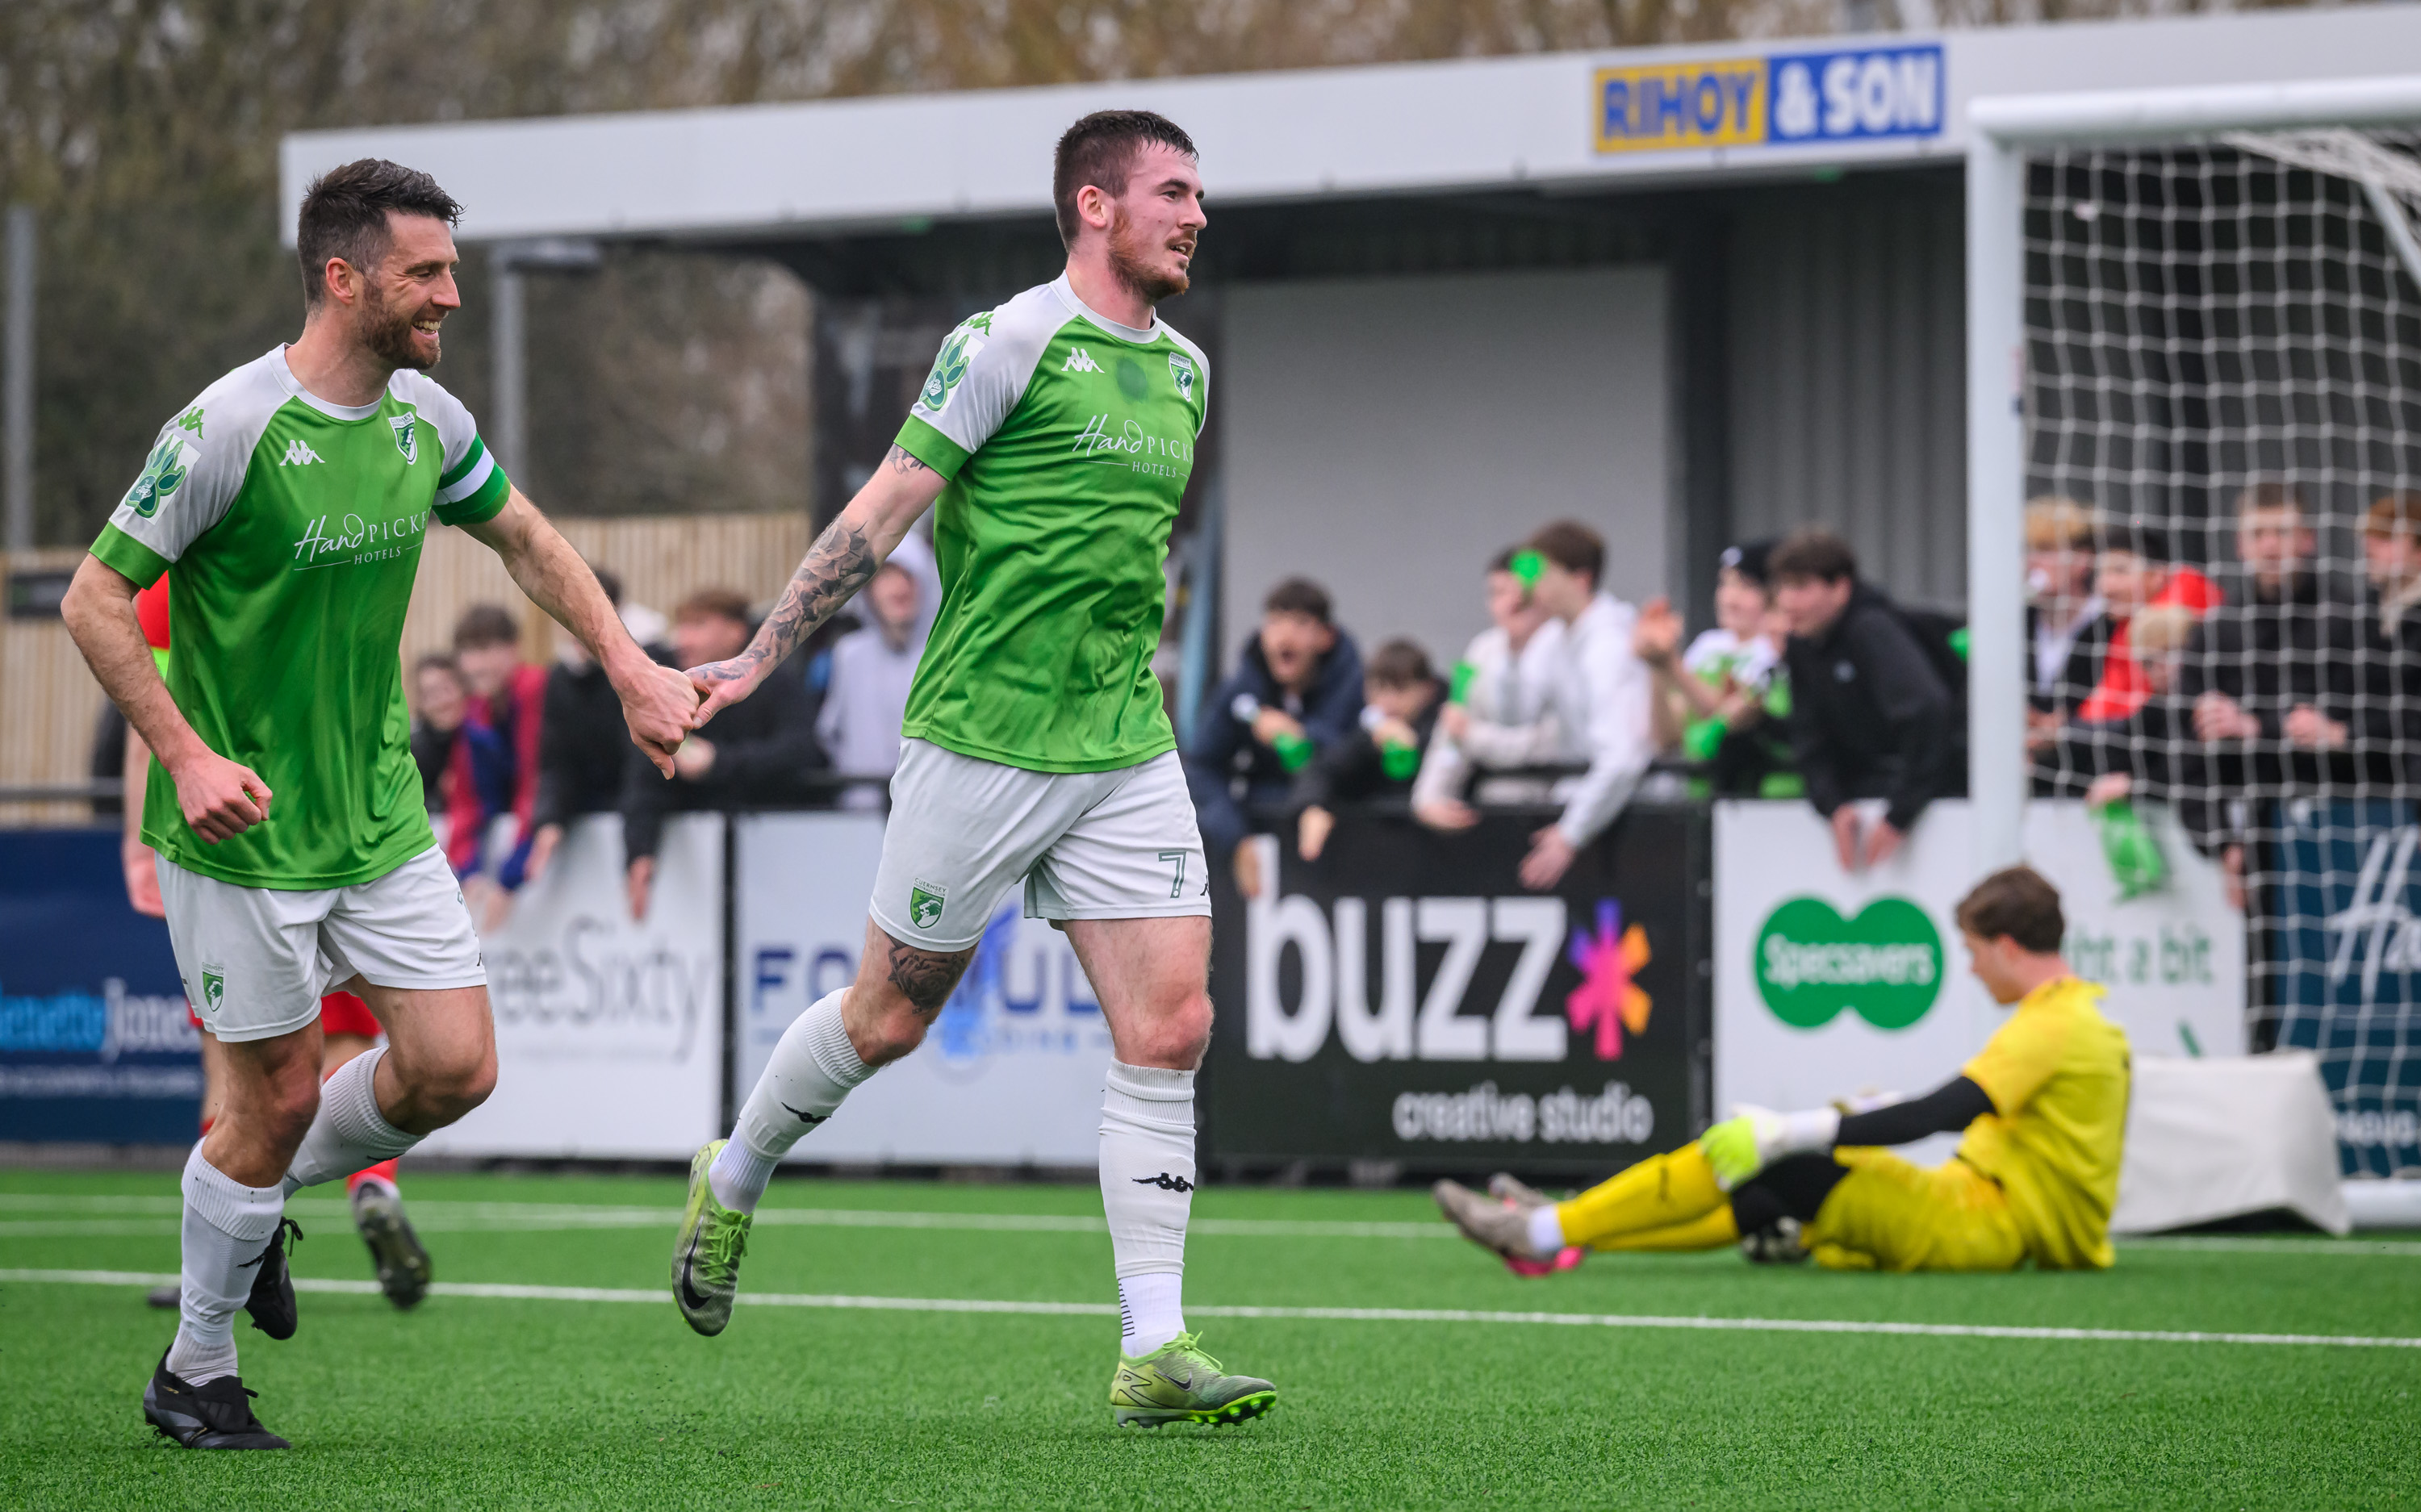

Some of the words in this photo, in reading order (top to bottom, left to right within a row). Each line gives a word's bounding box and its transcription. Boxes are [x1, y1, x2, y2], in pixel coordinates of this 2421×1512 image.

[1603, 71, 1756, 140] RIHOY
[1775, 60, 1821, 137] &
[1822, 52, 1938, 136] SON
[1131, 461, 1177, 478] HOTELS
[354, 545, 401, 565] HOTELS
[1158, 851, 1187, 899] 7
[1246, 833, 1568, 1063] buzz
[1762, 932, 1938, 992] Specsavers
[1391, 1079, 1535, 1142] creative
[1537, 1080, 1654, 1144] studio
